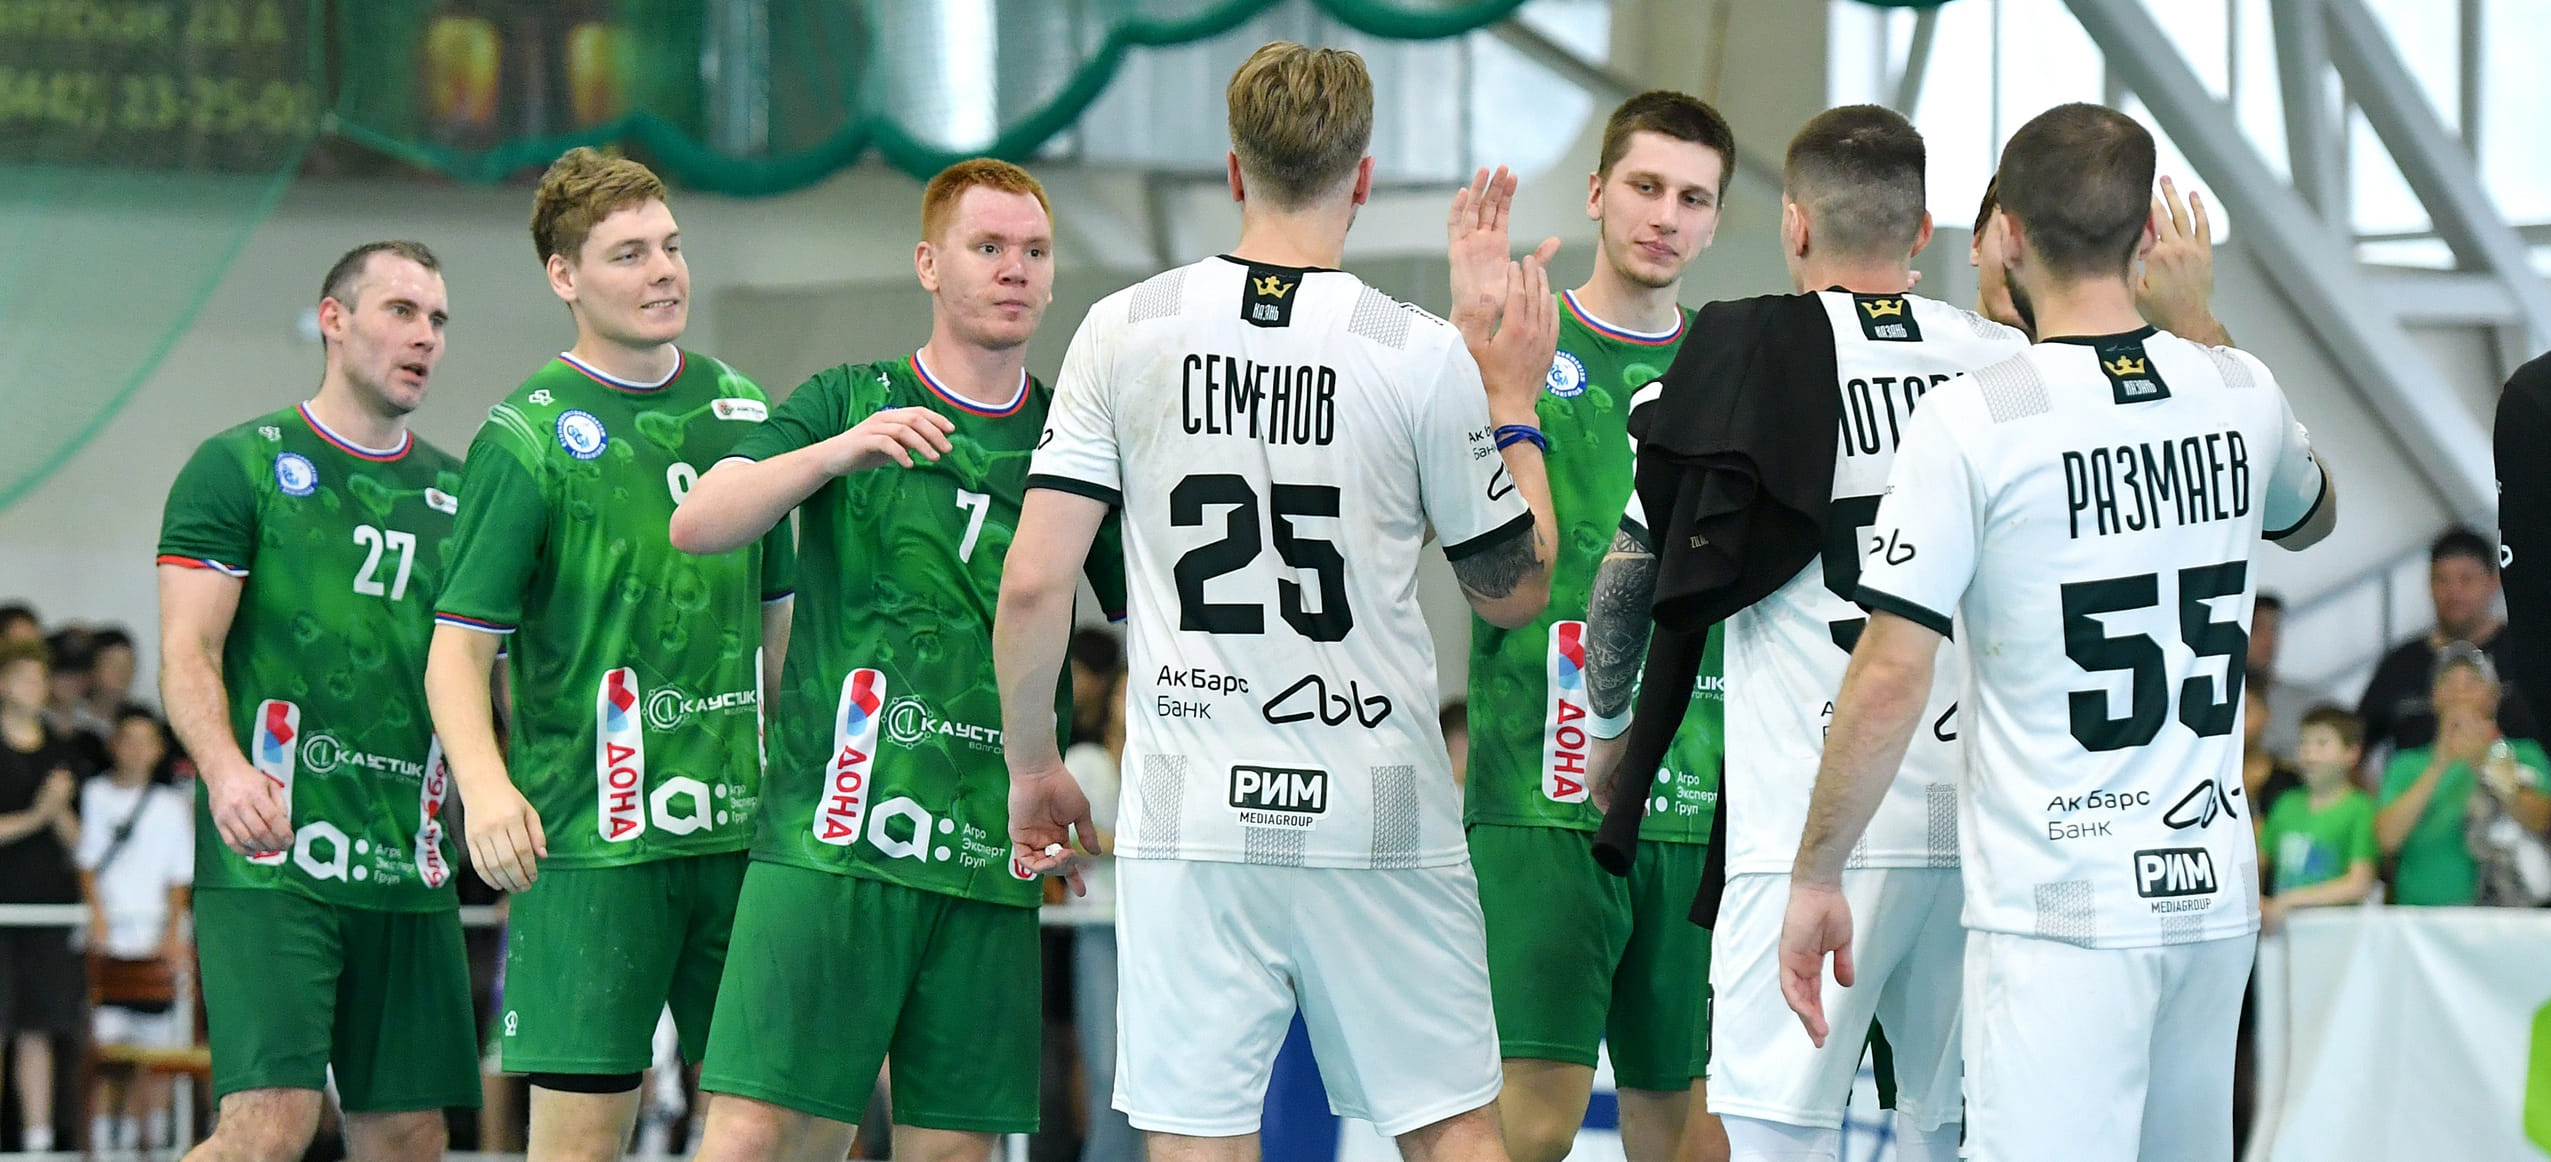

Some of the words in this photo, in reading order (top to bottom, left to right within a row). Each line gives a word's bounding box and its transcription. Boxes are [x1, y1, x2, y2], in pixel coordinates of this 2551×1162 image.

[1182, 353, 1337, 446] СЕМЕНОВ
[2062, 430, 2250, 539] РАЗМАЕВ
[956, 488, 991, 564] 7
[353, 524, 416, 601] 27
[1169, 474, 1354, 642] 25
[2060, 559, 2250, 753] 55
[1156, 695, 1212, 720] Банк
[1552, 698, 1586, 798] ДОНА
[606, 742, 638, 839] ДОНА
[822, 745, 867, 840] ДОНА
[1233, 769, 1323, 809] РИМ
[1676, 771, 1700, 787] Агро
[1239, 811, 1314, 828] MEDIAGROUP
[1674, 800, 1699, 816] Груп
[962, 823, 987, 840] Агро
[2048, 820, 2113, 840] Банк
[959, 852, 987, 869] Груп
[2137, 852, 2214, 893] РИМ
[2151, 897, 2212, 914] MEDIAGROUP
